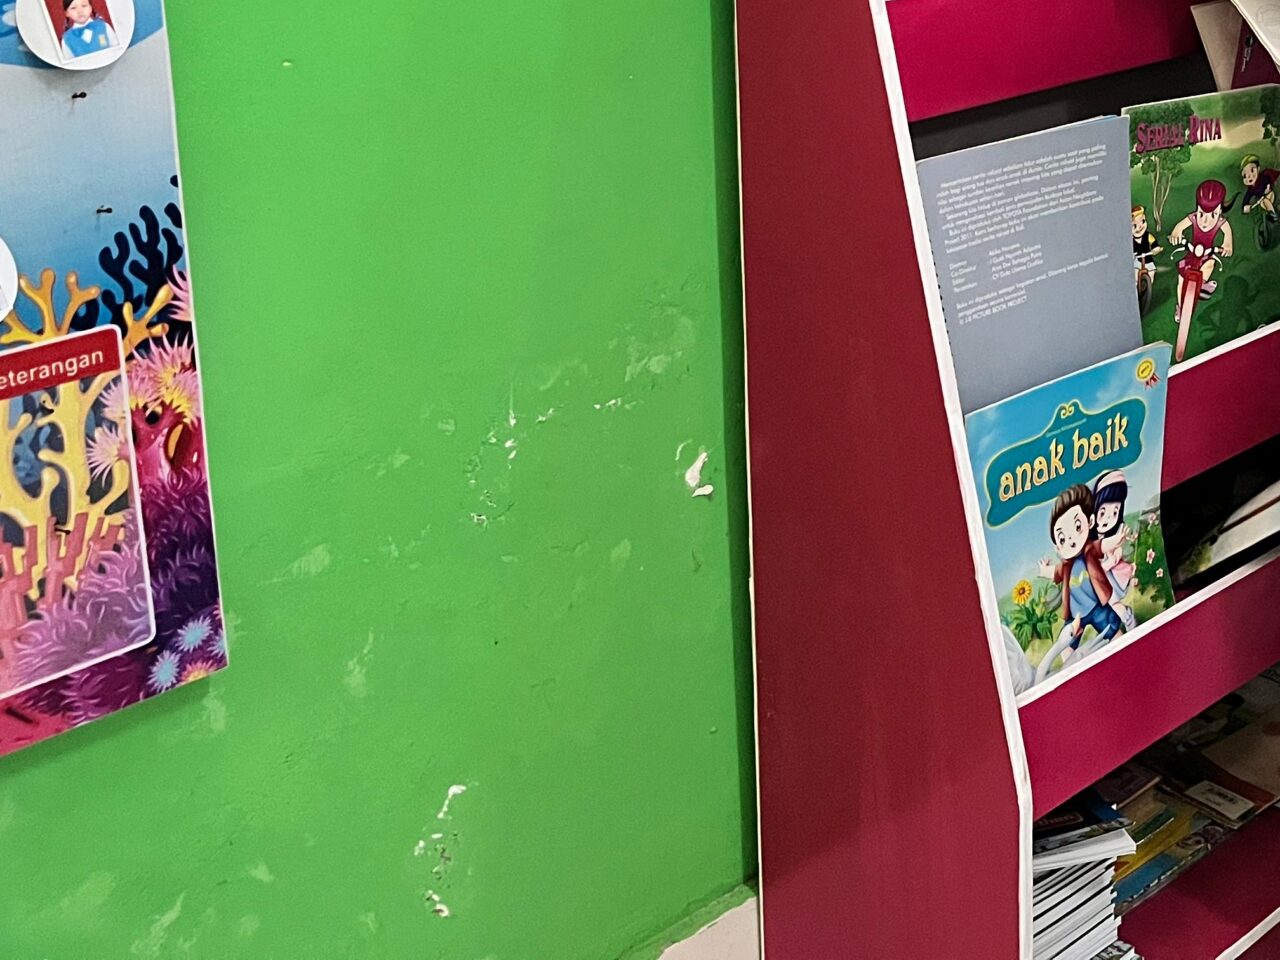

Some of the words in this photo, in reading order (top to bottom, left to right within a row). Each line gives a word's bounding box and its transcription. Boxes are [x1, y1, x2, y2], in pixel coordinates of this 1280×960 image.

[1188, 114, 1222, 144] RINA
[0, 350, 104, 390] eterangan
[999, 438, 1066, 502] anak
[1072, 412, 1129, 469] baik
